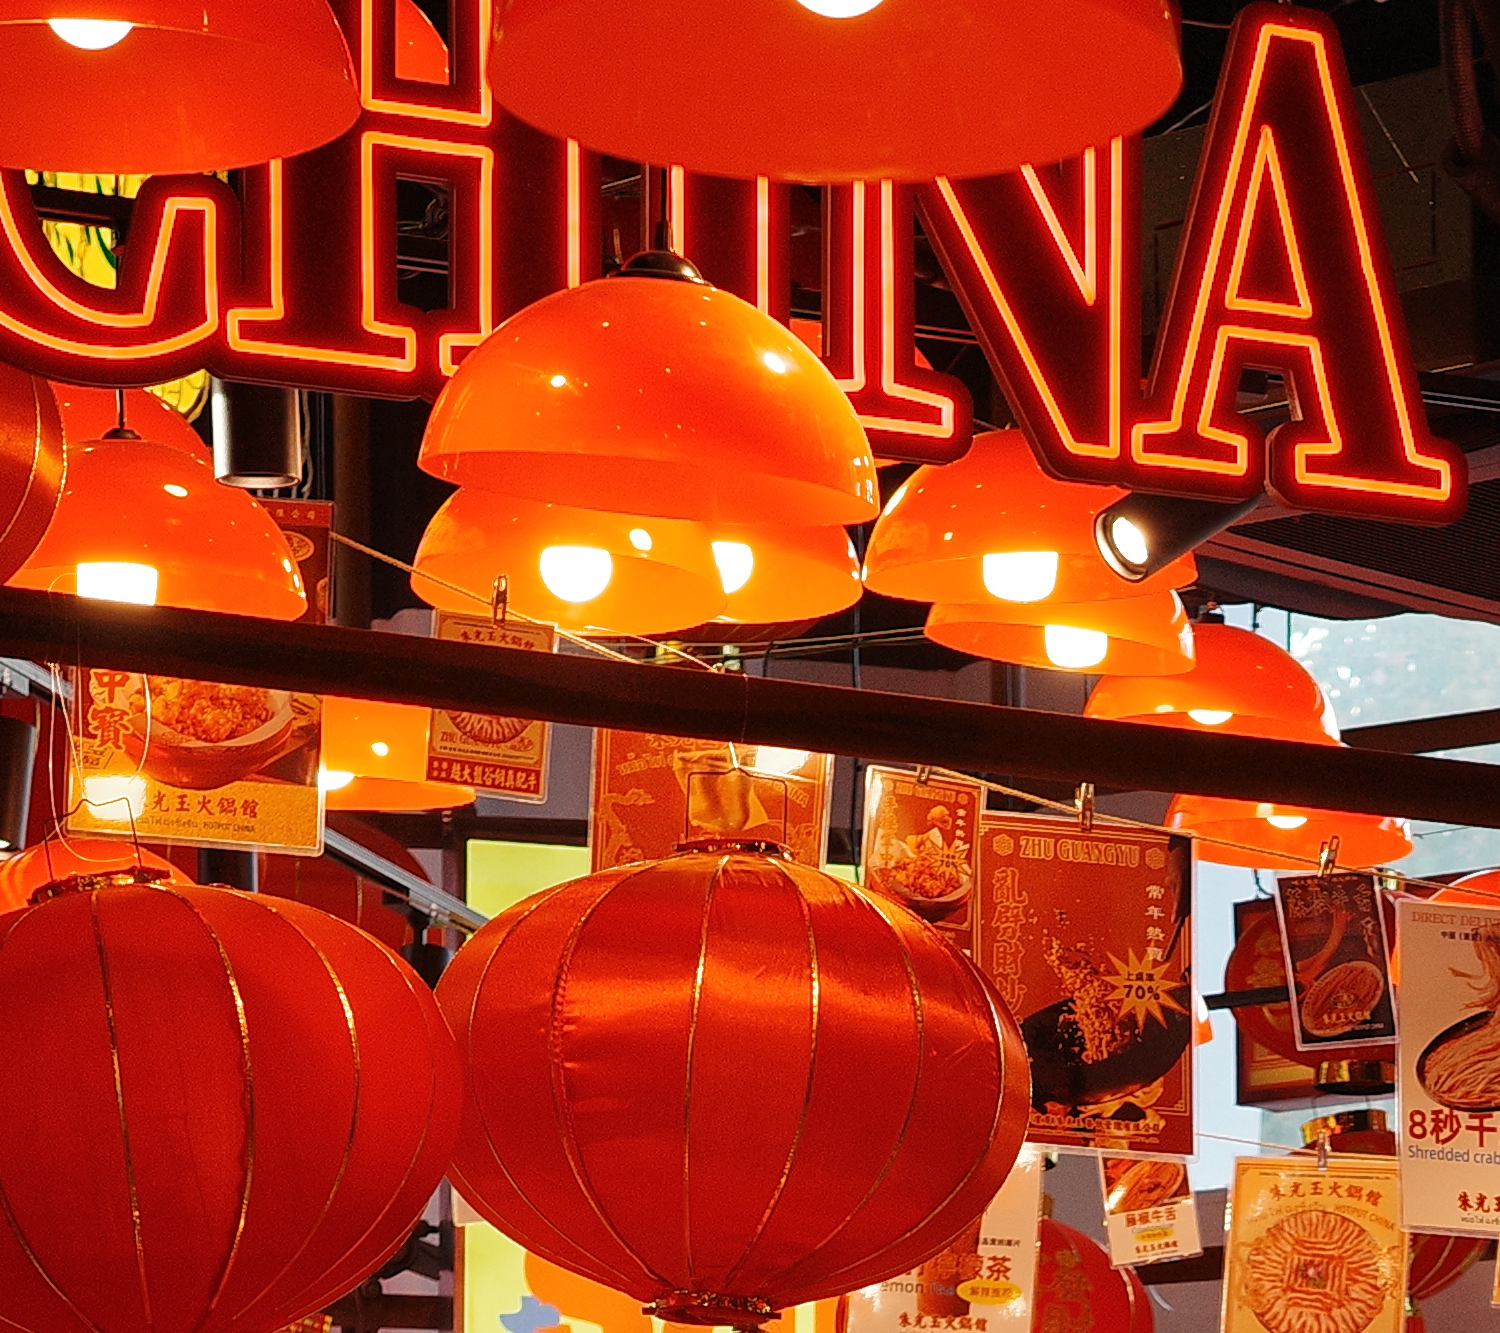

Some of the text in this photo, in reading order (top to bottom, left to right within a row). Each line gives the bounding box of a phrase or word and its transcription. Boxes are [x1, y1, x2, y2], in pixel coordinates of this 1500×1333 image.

[152, 790, 260, 819] 光玉火鍋館
[1019, 836, 1141, 869] ZHU GUANGYU
[1123, 983, 1161, 1001] 70%
[1408, 1145, 1470, 1164] Shredded
